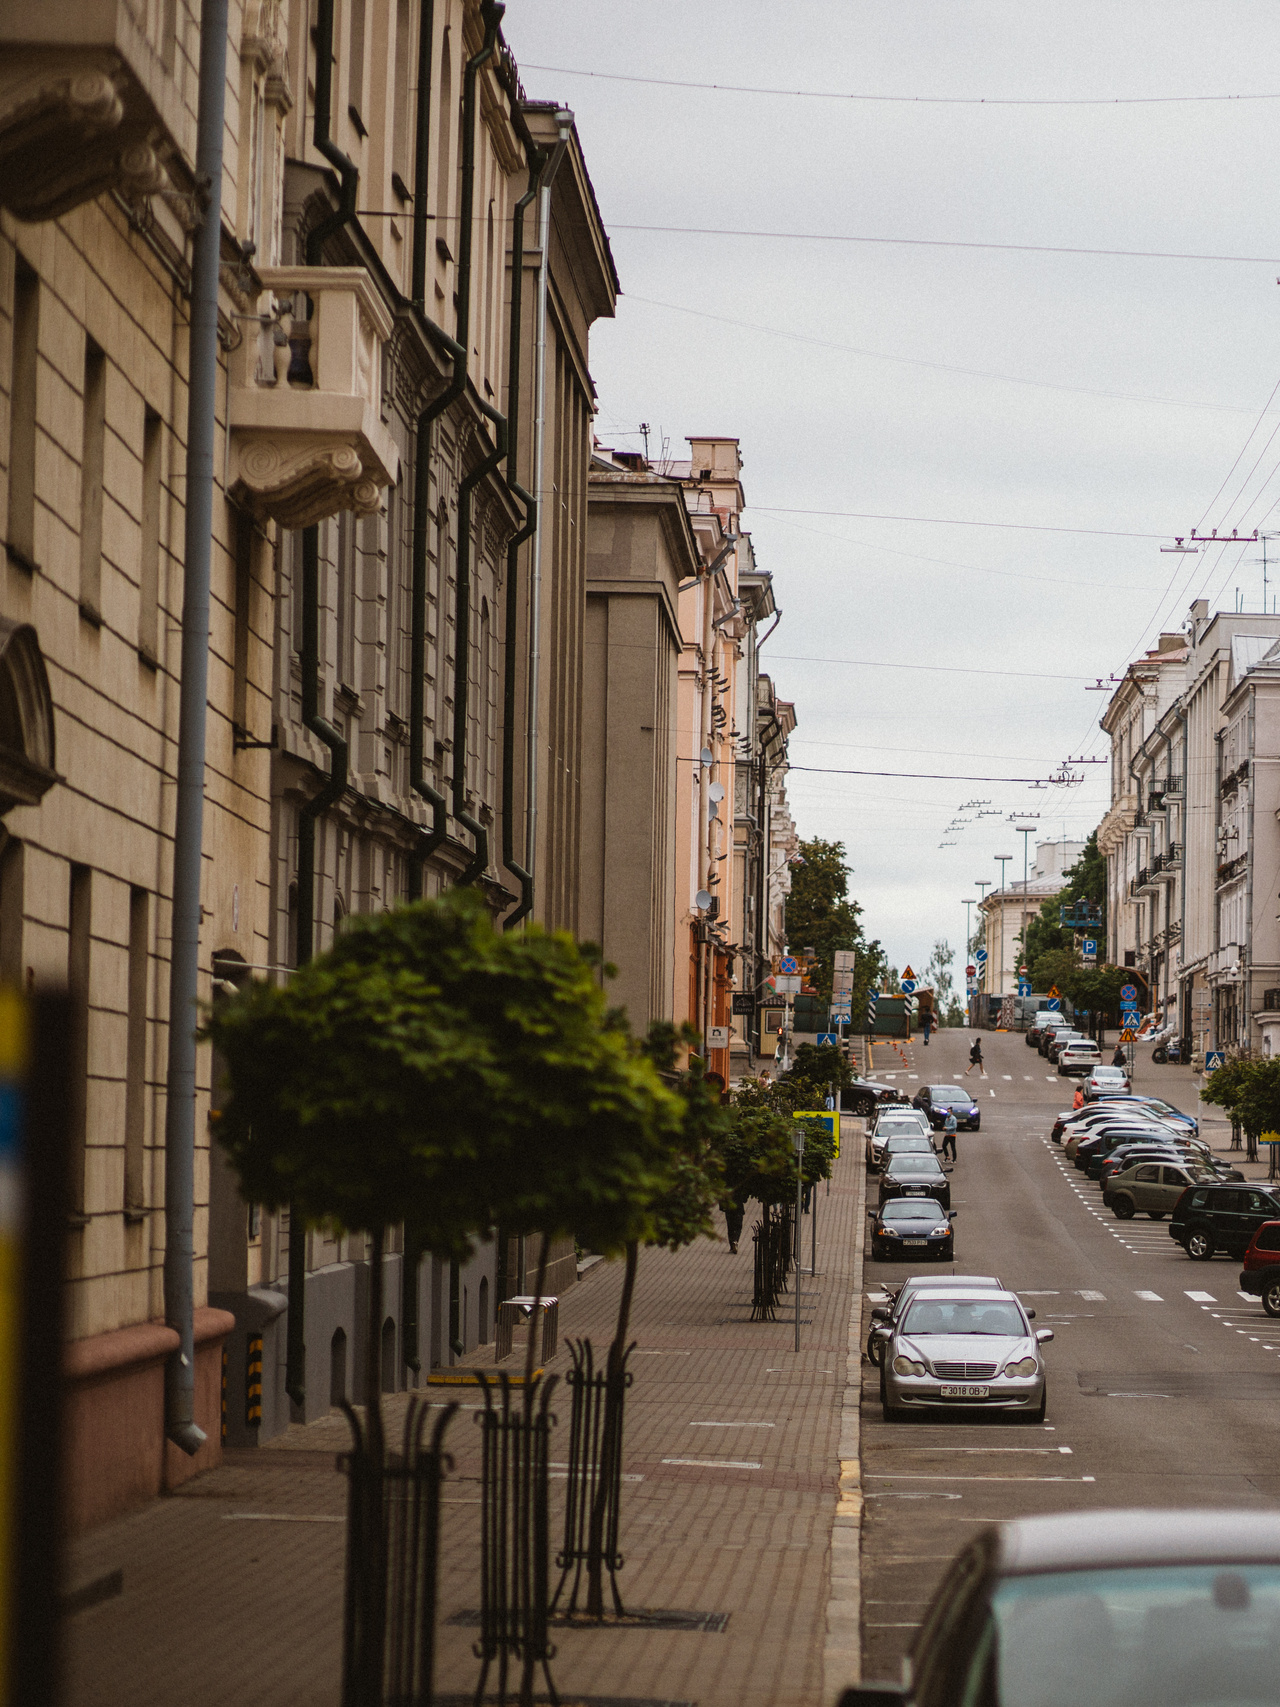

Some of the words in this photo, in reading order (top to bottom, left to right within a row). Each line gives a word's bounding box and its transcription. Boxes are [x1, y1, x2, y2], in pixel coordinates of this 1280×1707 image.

[1086, 942, 1094, 952] P
[949, 1387, 967, 1395] 3018
[969, 1387, 988, 1395] OB-7
